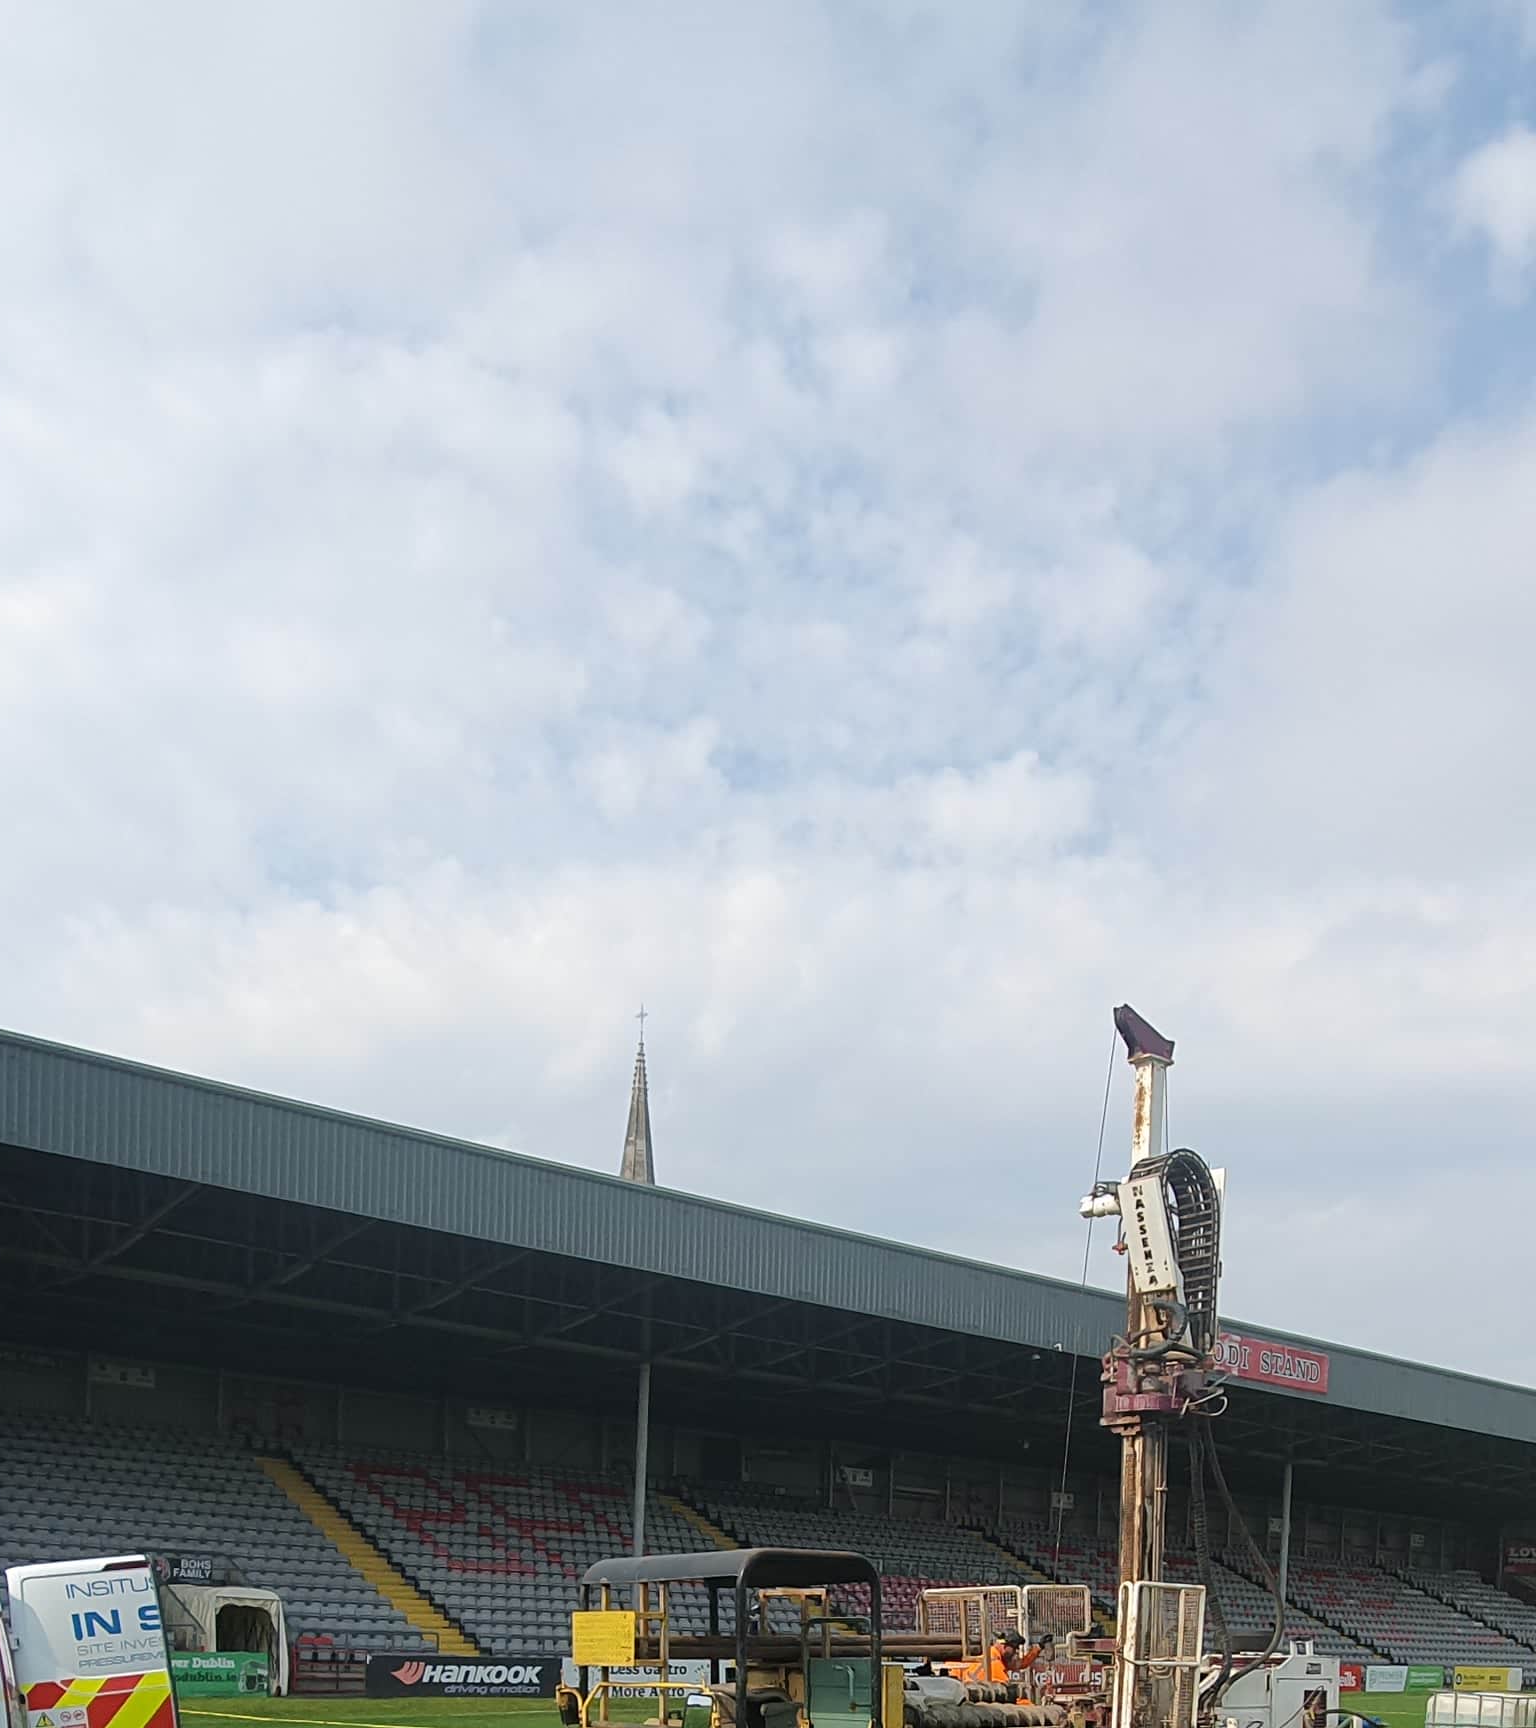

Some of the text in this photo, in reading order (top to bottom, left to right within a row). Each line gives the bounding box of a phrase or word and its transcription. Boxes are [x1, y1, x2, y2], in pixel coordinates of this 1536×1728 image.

[1213, 1342, 1321, 1384] ODI STAND
[180, 1559, 212, 1569] BOHS
[172, 1567, 212, 1579] FAMILY
[71, 1608, 123, 1642] IN
[76, 1641, 114, 1657] SITE
[191, 1656, 236, 1669] Dublin
[610, 1664, 640, 1675] Less
[643, 1664, 688, 1675] Gatro
[444, 1685, 541, 1696] driving emotion
[611, 1686, 685, 1697] More Atro
